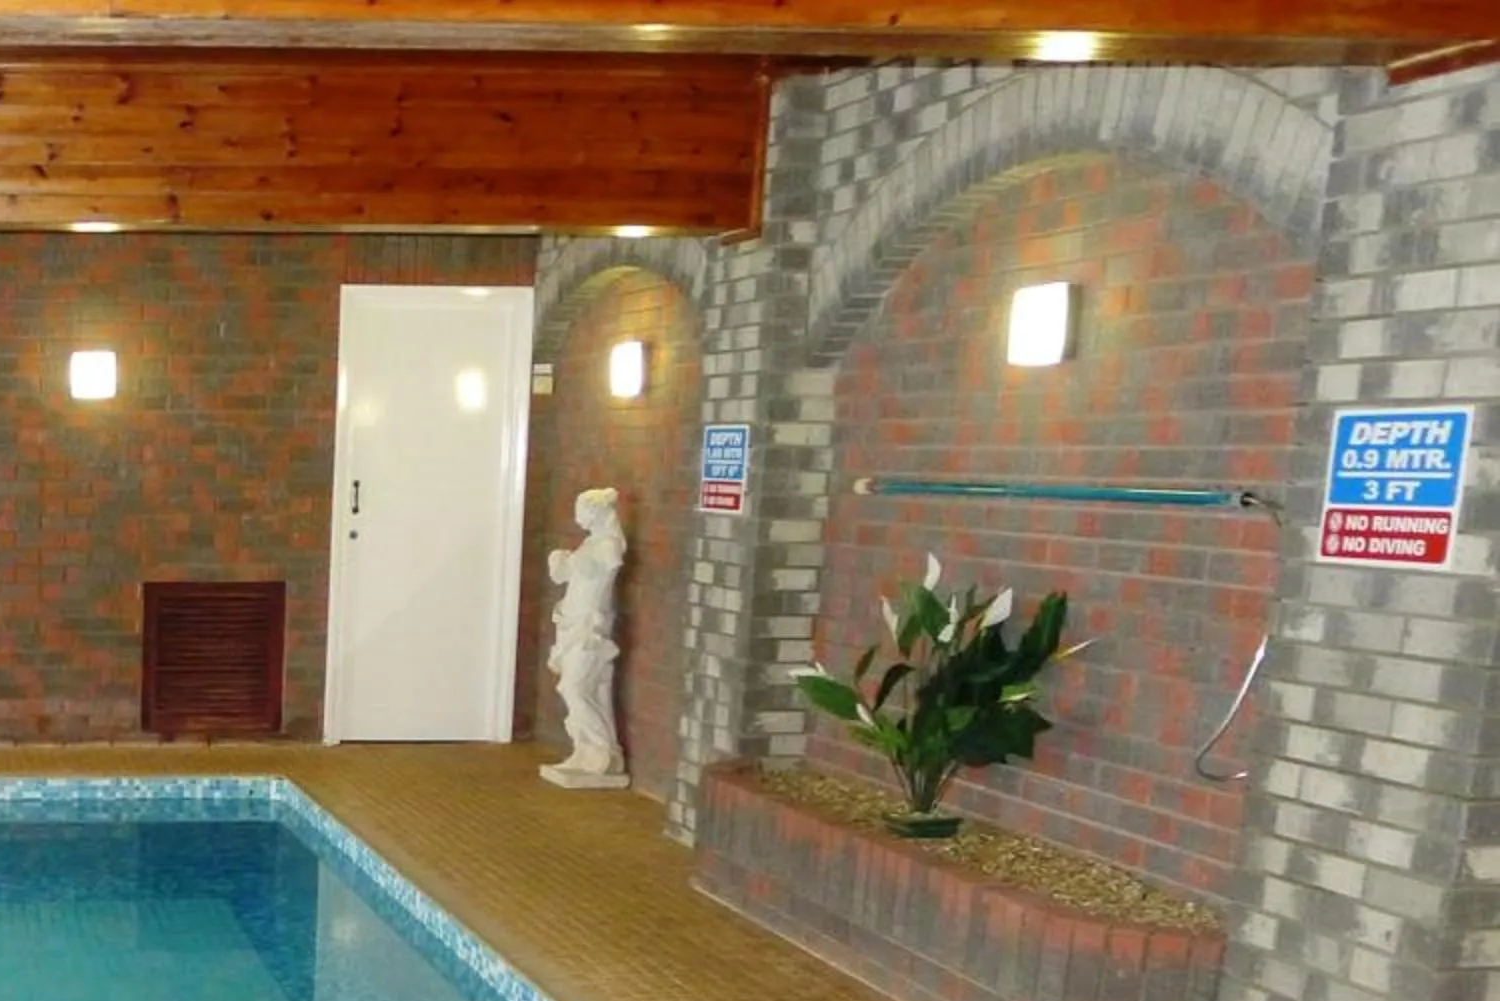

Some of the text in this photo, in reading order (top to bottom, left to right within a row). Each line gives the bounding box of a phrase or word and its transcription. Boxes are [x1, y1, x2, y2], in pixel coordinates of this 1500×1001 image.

[710, 431, 743, 447] DEPTH
[1348, 420, 1454, 446] DEPTH
[1341, 448, 1452, 470] 0.9 MTR.
[1361, 479, 1422, 502] 3 FT
[1344, 514, 1449, 535] NO RUNNING
[1341, 535, 1427, 557] NO DIVING
